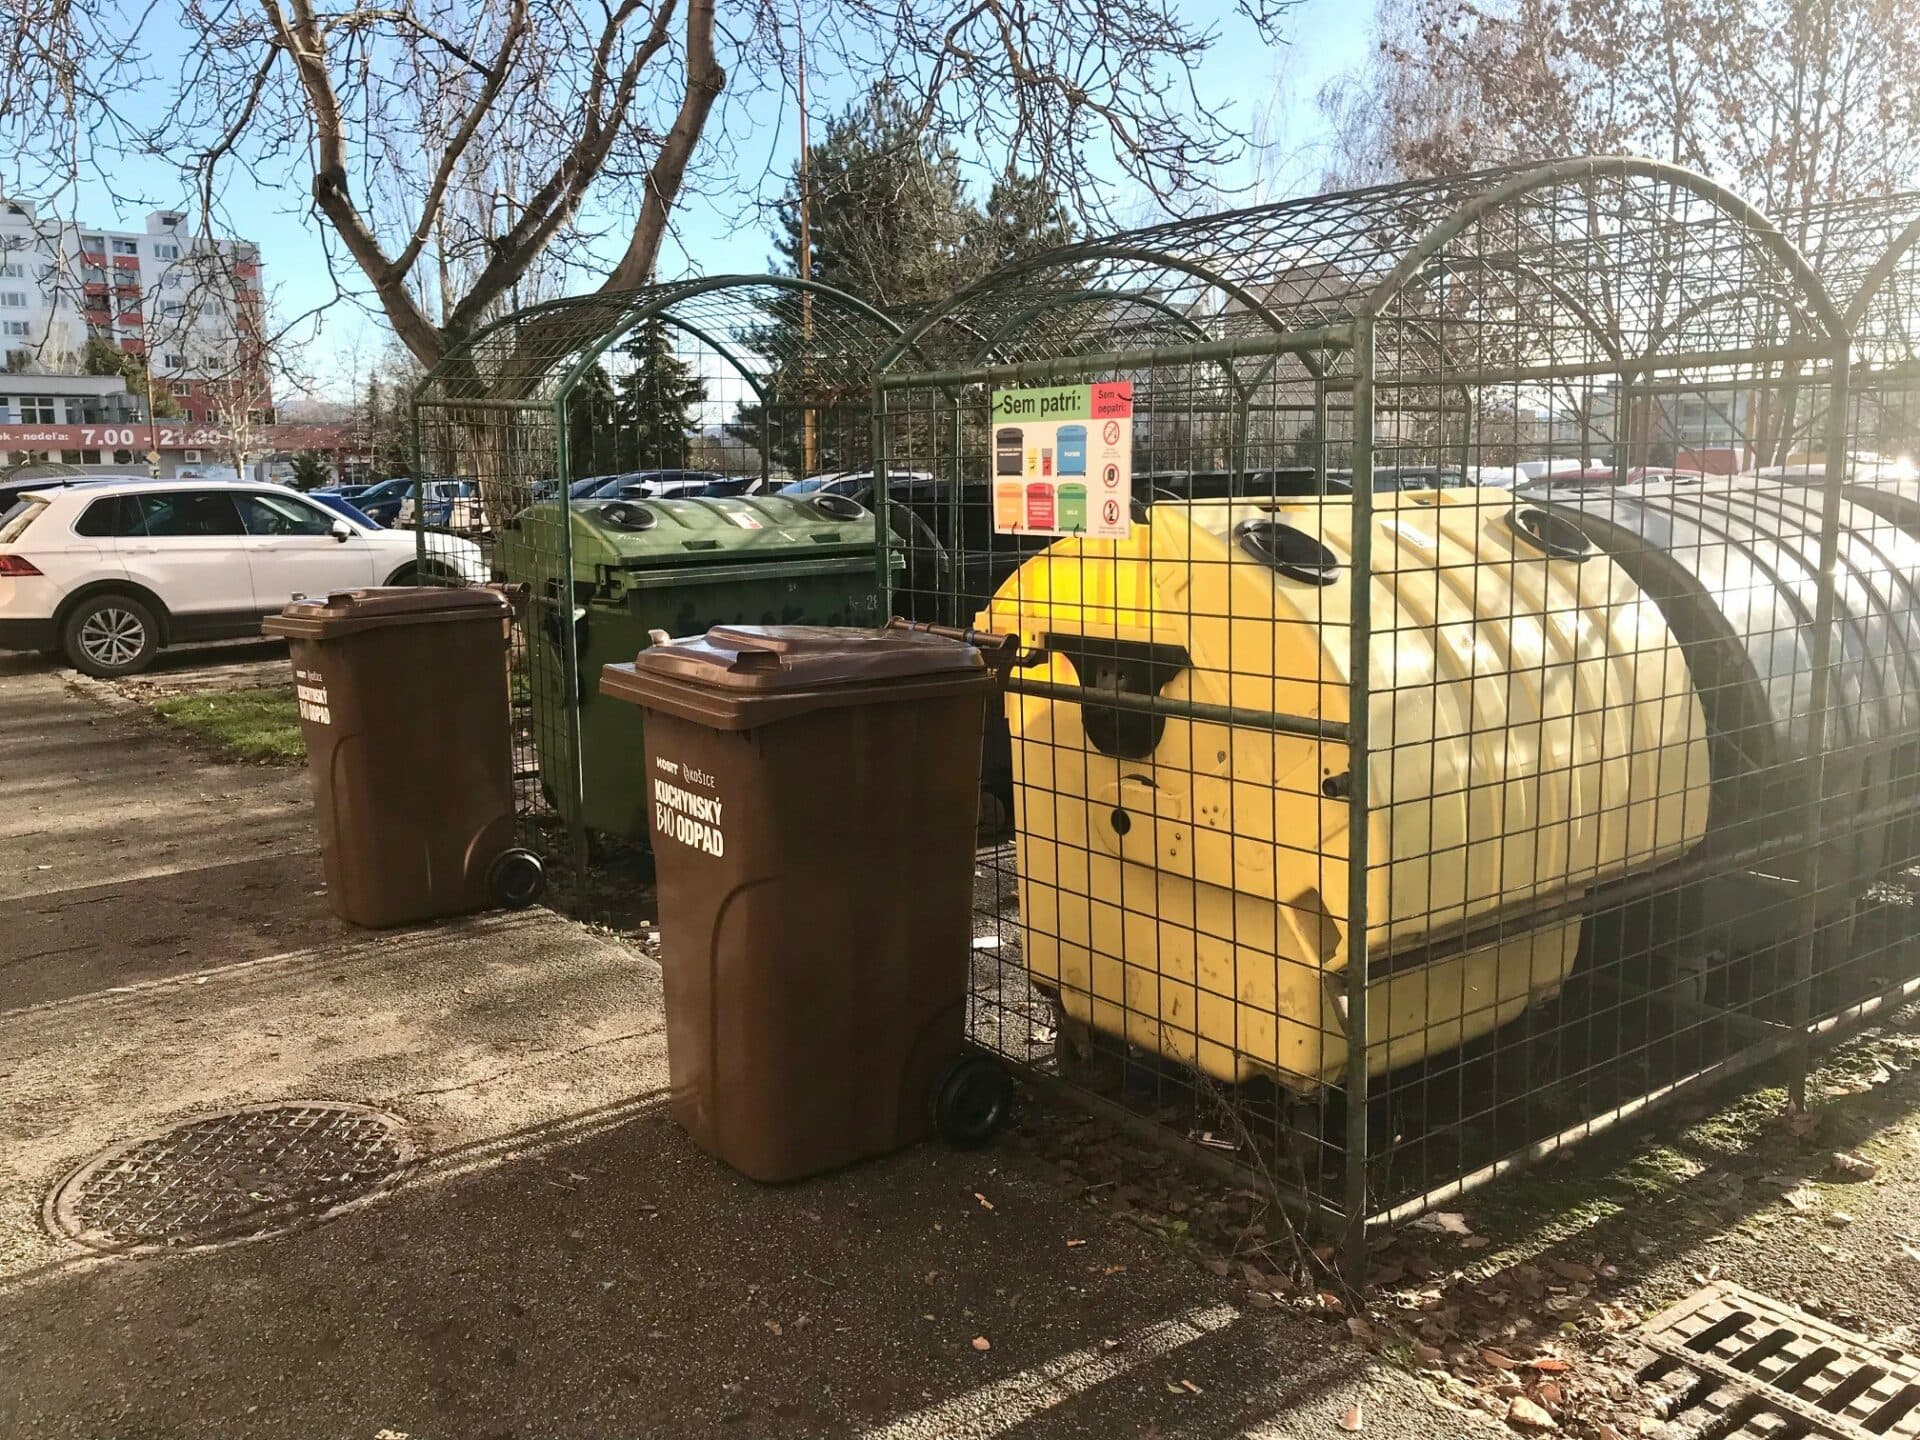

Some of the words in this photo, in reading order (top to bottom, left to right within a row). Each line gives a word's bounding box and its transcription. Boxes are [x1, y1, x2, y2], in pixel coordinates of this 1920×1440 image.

[1003, 394, 1035, 415] Sem
[1040, 389, 1081, 417] patrí:
[1098, 390, 1115, 400] Sem
[81, 429, 134, 446] 7.00
[655, 778, 722, 826] KUCHYNSKÝ
[655, 802, 675, 838] BIO
[676, 814, 724, 857] ODPAD
